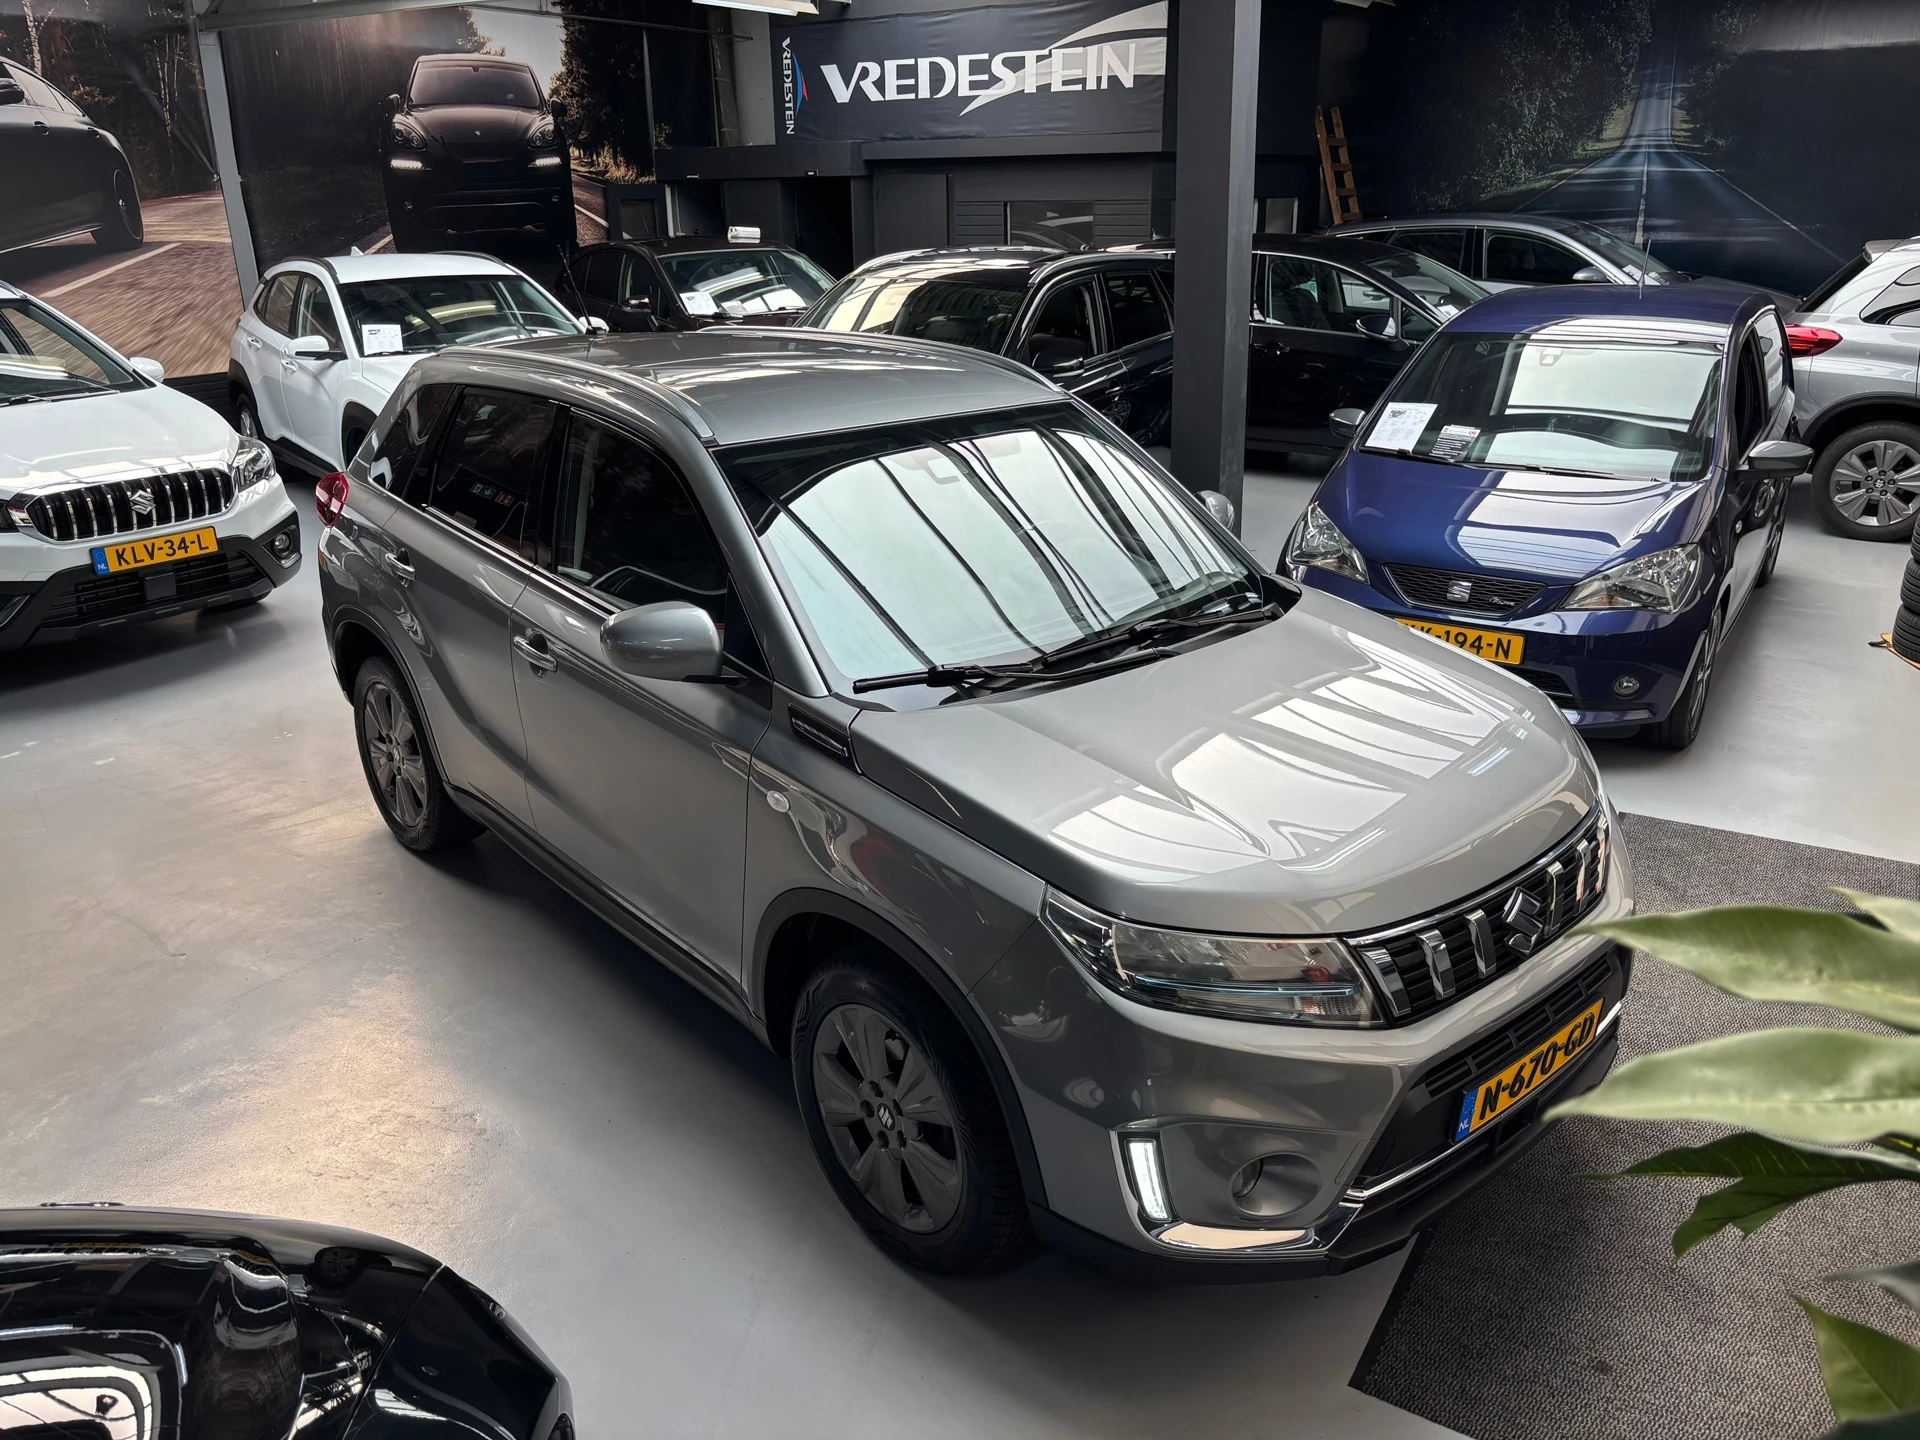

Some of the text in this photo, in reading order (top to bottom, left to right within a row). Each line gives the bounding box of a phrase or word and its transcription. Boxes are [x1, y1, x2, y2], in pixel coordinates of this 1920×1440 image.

[782, 36, 795, 135] VREDESTEIN
[820, 43, 1136, 116] VREDESTEIN
[115, 534, 209, 566] KLV-34-L
[1405, 623, 1512, 660] -194-N
[1458, 1012, 1596, 1132] NL N-670-GD
